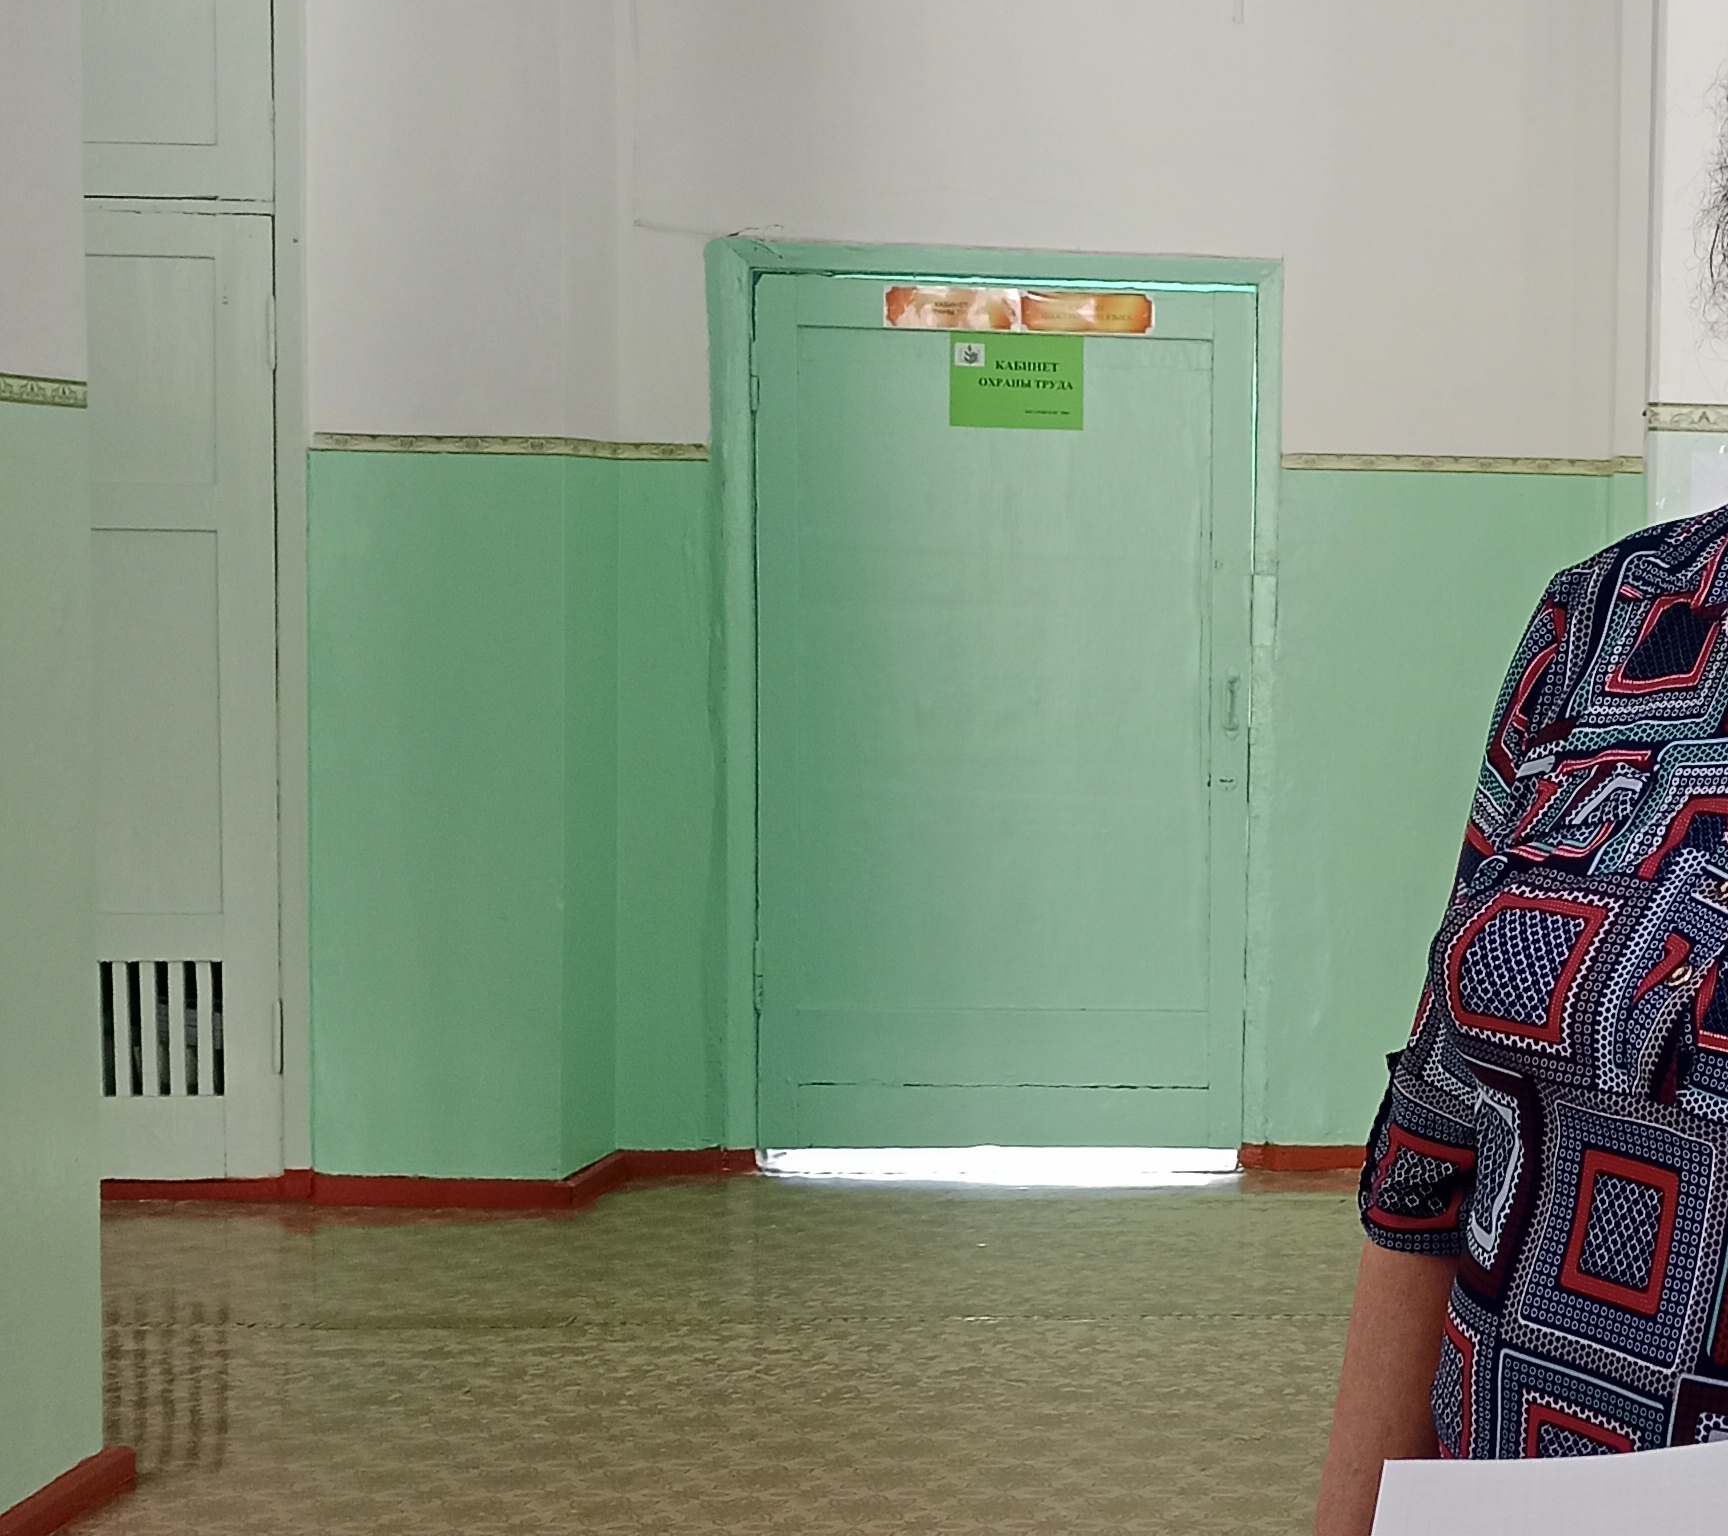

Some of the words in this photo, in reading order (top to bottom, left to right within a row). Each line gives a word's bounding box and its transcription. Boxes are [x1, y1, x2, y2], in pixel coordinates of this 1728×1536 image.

[995, 359, 1060, 373] КАБИНЕТ
[978, 377, 1032, 389] ОХРАНЫ
[1035, 379, 1074, 391] ТРУДА
